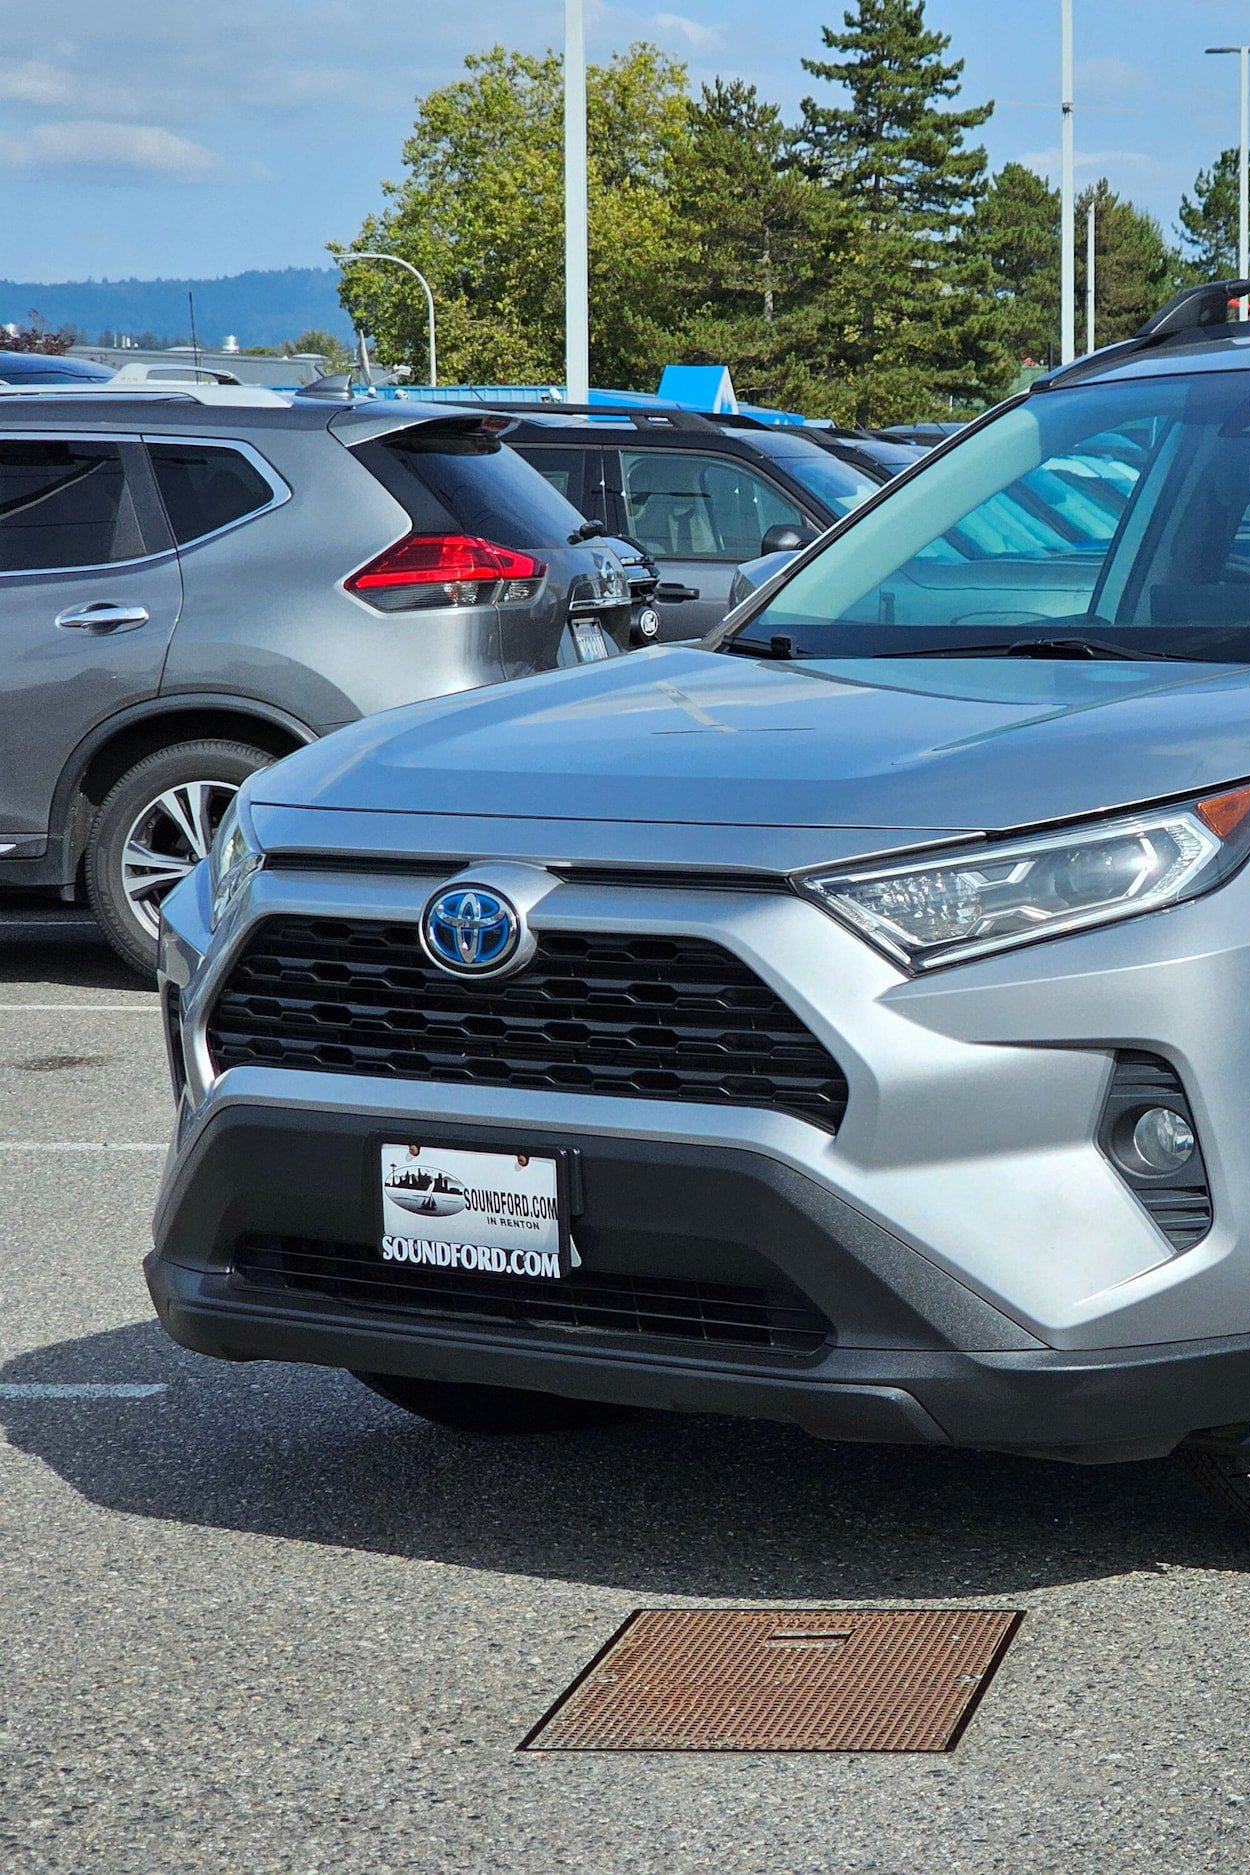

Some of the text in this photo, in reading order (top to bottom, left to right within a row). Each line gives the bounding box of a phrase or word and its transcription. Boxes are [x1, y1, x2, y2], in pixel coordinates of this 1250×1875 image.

[463, 1187, 558, 1221] SOUNDFORD.COM
[487, 1216, 540, 1231] IN RENTON
[381, 1234, 561, 1279] SOUNDFORD.COM
